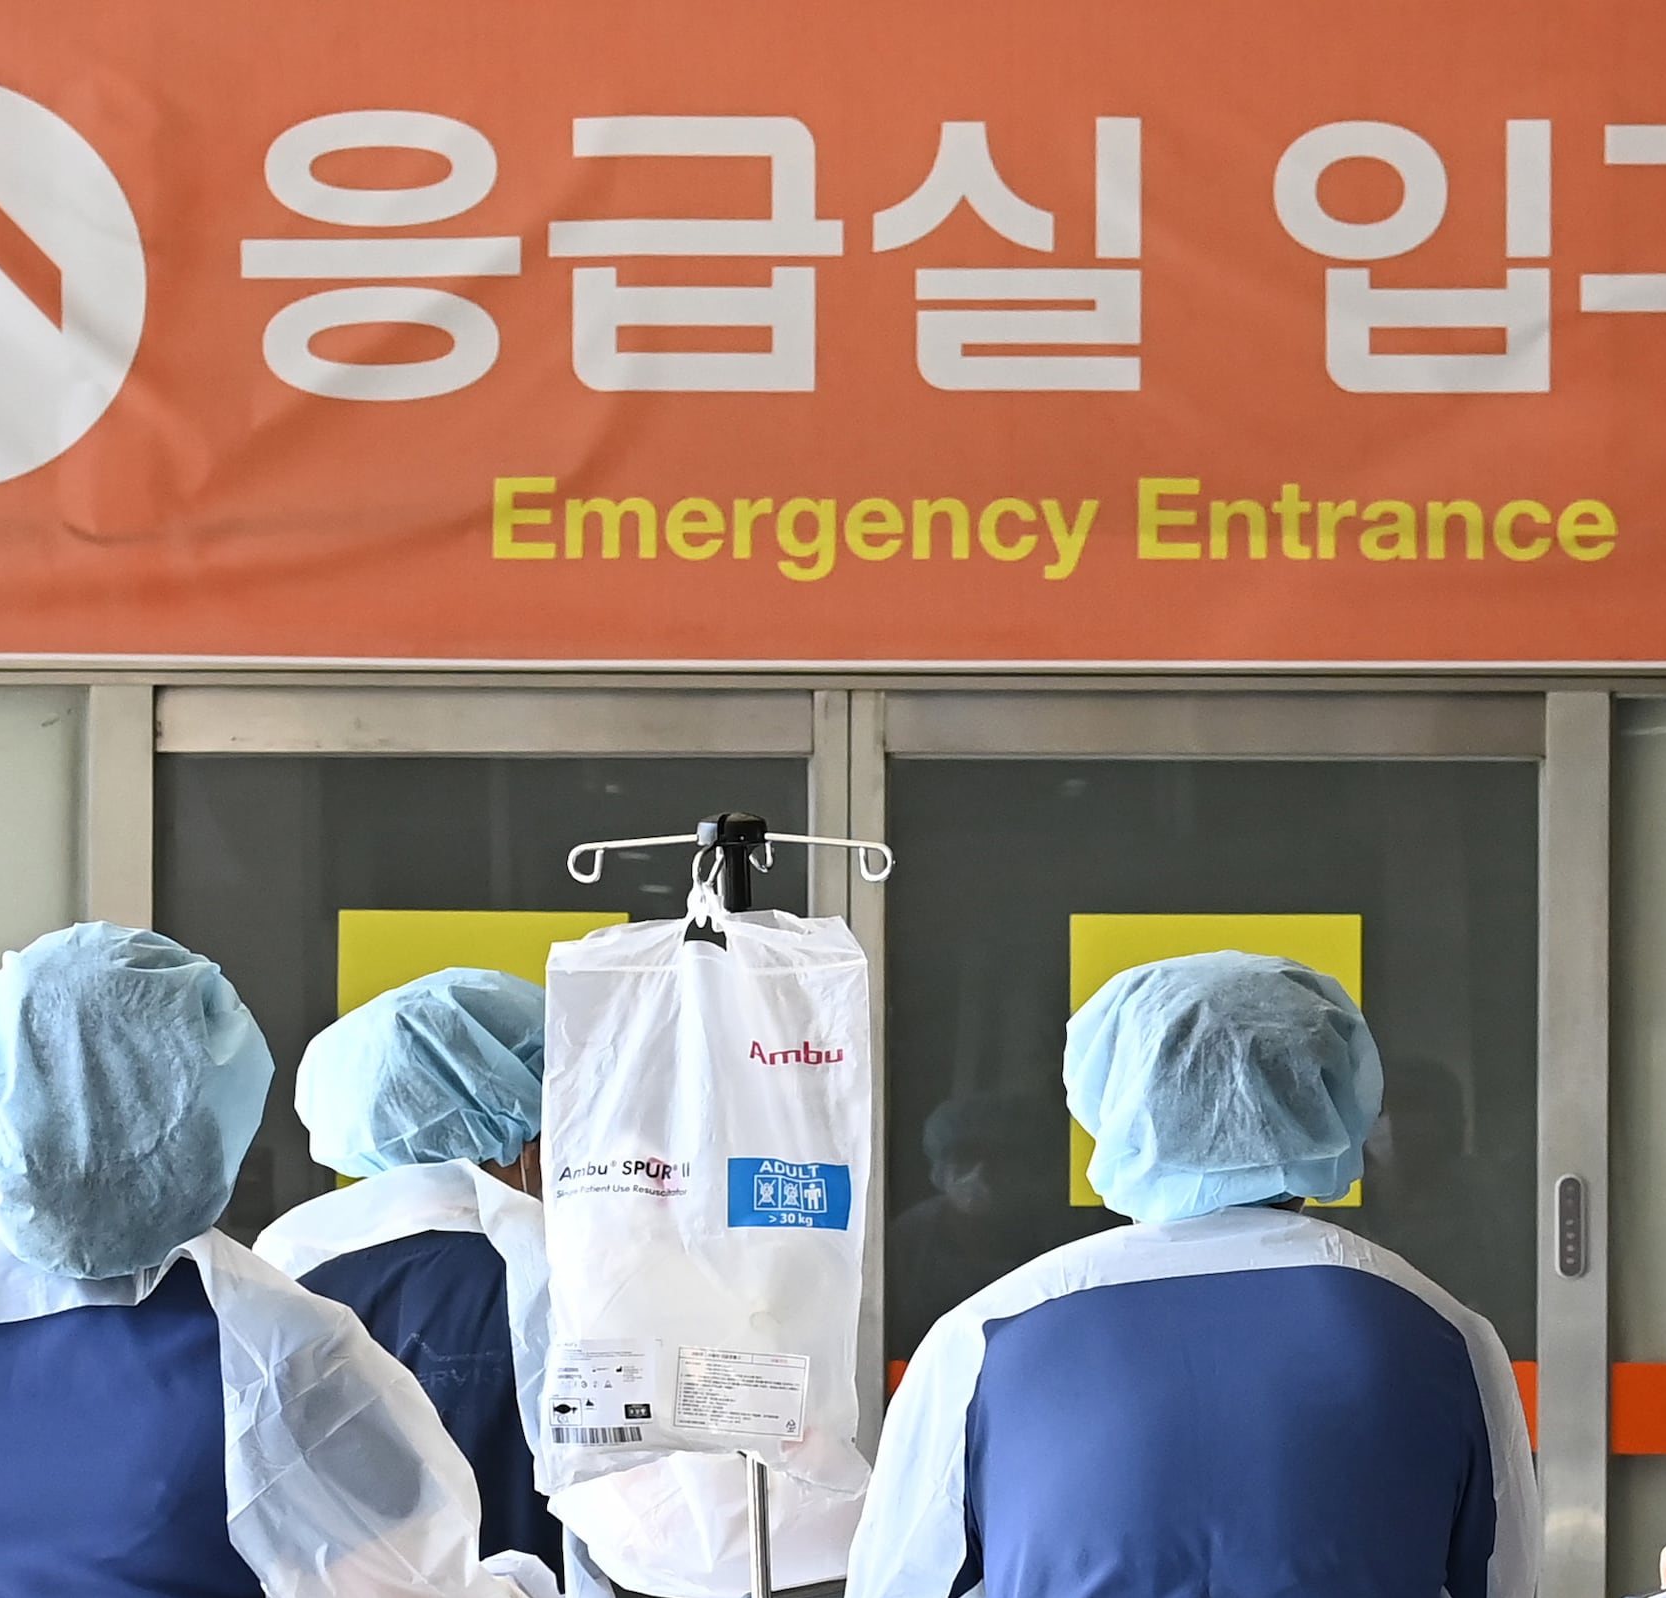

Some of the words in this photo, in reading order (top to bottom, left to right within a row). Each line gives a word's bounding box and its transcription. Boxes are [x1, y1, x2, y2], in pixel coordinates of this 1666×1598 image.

[241, 109, 1142, 402] 응급실
[491, 475, 1099, 582] Emergency
[1137, 476, 1619, 562] Entrance
[749, 1040, 844, 1065] Ambu
[759, 1160, 820, 1179] ADULT
[612, 1184, 631, 1193] Use
[779, 1212, 796, 1224] 30
[798, 1212, 814, 1227] kg
